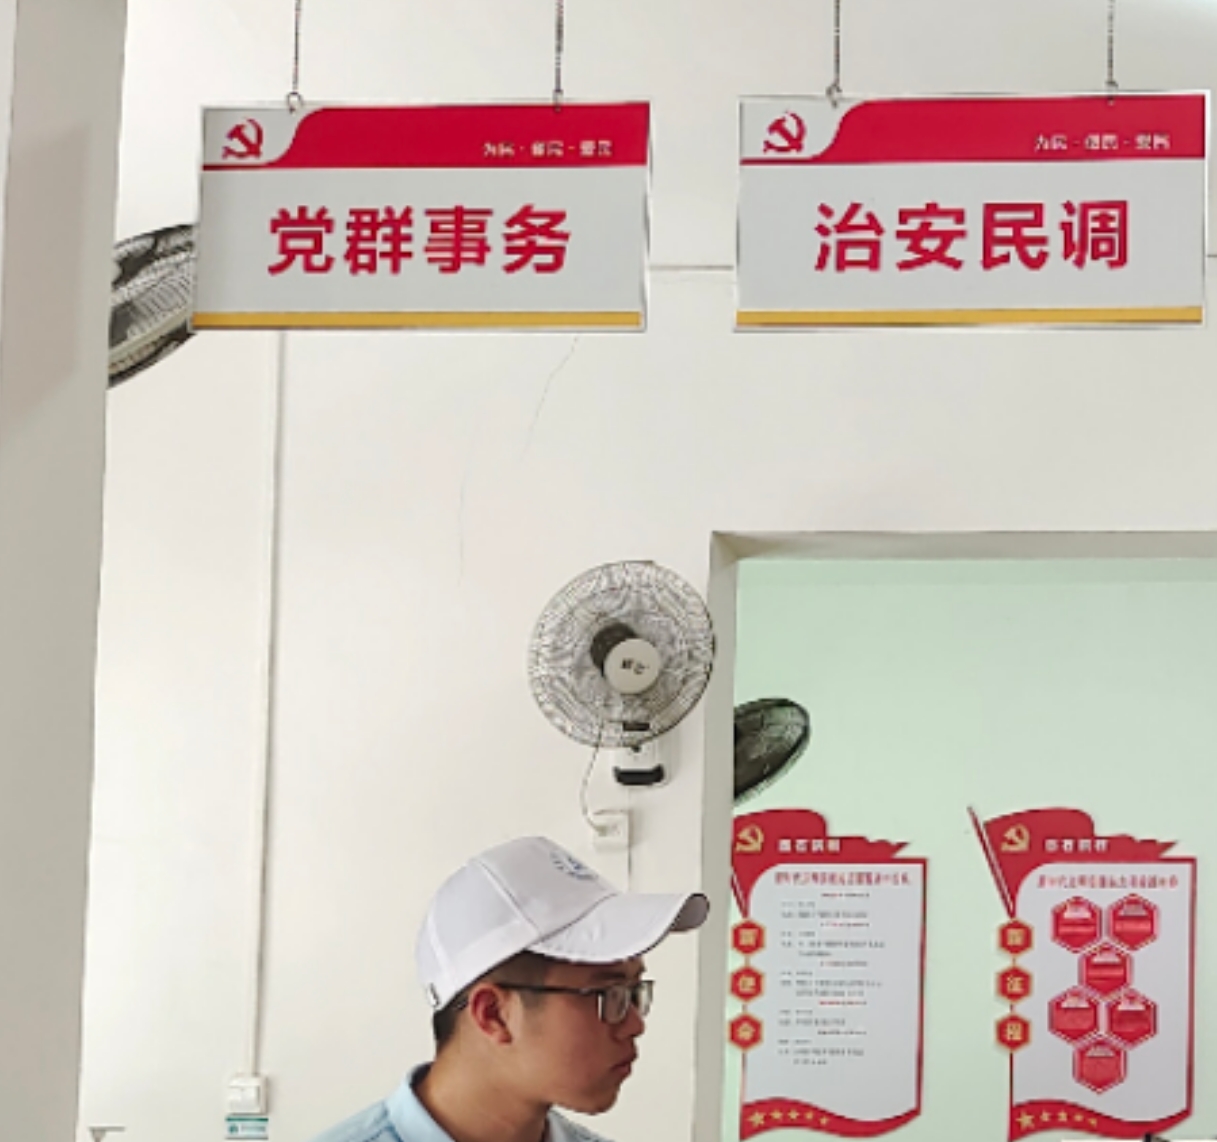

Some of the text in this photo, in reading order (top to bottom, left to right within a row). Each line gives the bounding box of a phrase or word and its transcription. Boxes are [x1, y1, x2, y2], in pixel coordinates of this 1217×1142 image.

[268, 204, 571, 276] 党群事务
[814, 200, 1129, 272] 治安民调
